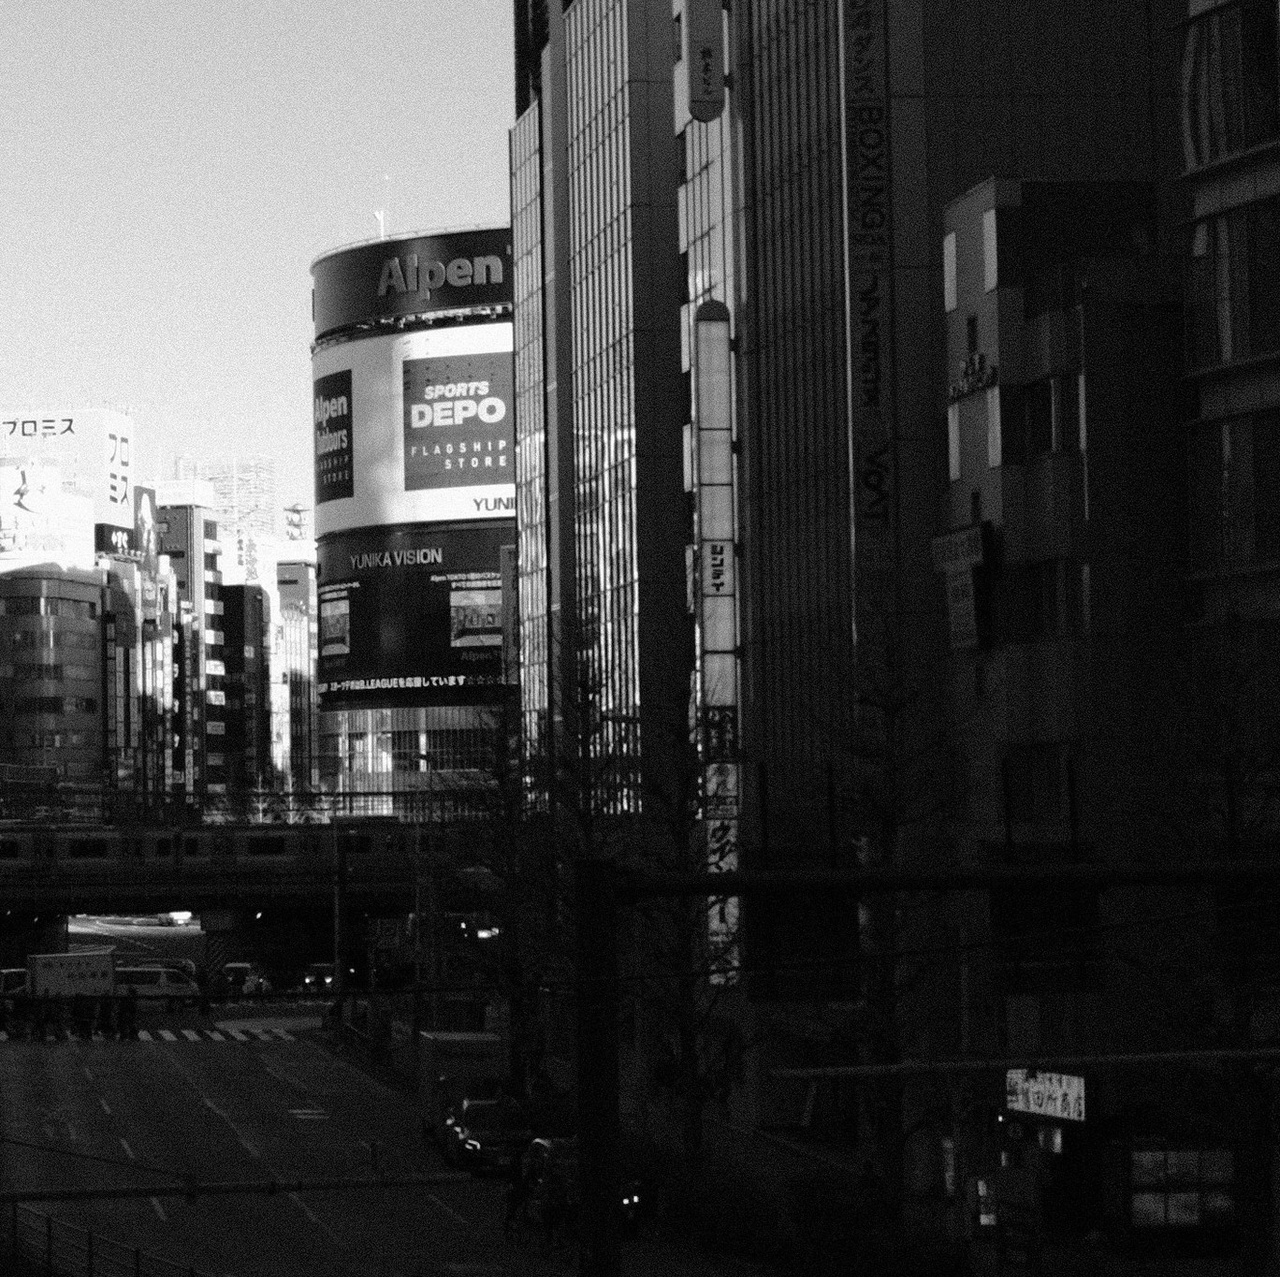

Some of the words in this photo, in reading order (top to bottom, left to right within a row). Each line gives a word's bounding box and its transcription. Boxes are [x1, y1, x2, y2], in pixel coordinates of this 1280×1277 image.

[858, 106, 886, 229] BOXING
[377, 254, 504, 300] Alpen
[424, 381, 490, 400] SPORTS
[315, 395, 348, 427] Alpen
[410, 397, 507, 428] DEPO
[1, 417, 76, 438] プロミス
[411, 440, 507, 457] FLAGSHIP
[445, 455, 507, 470] STORE
[350, 551, 392, 569] YUNIKA
[393, 547, 442, 566] VISION
